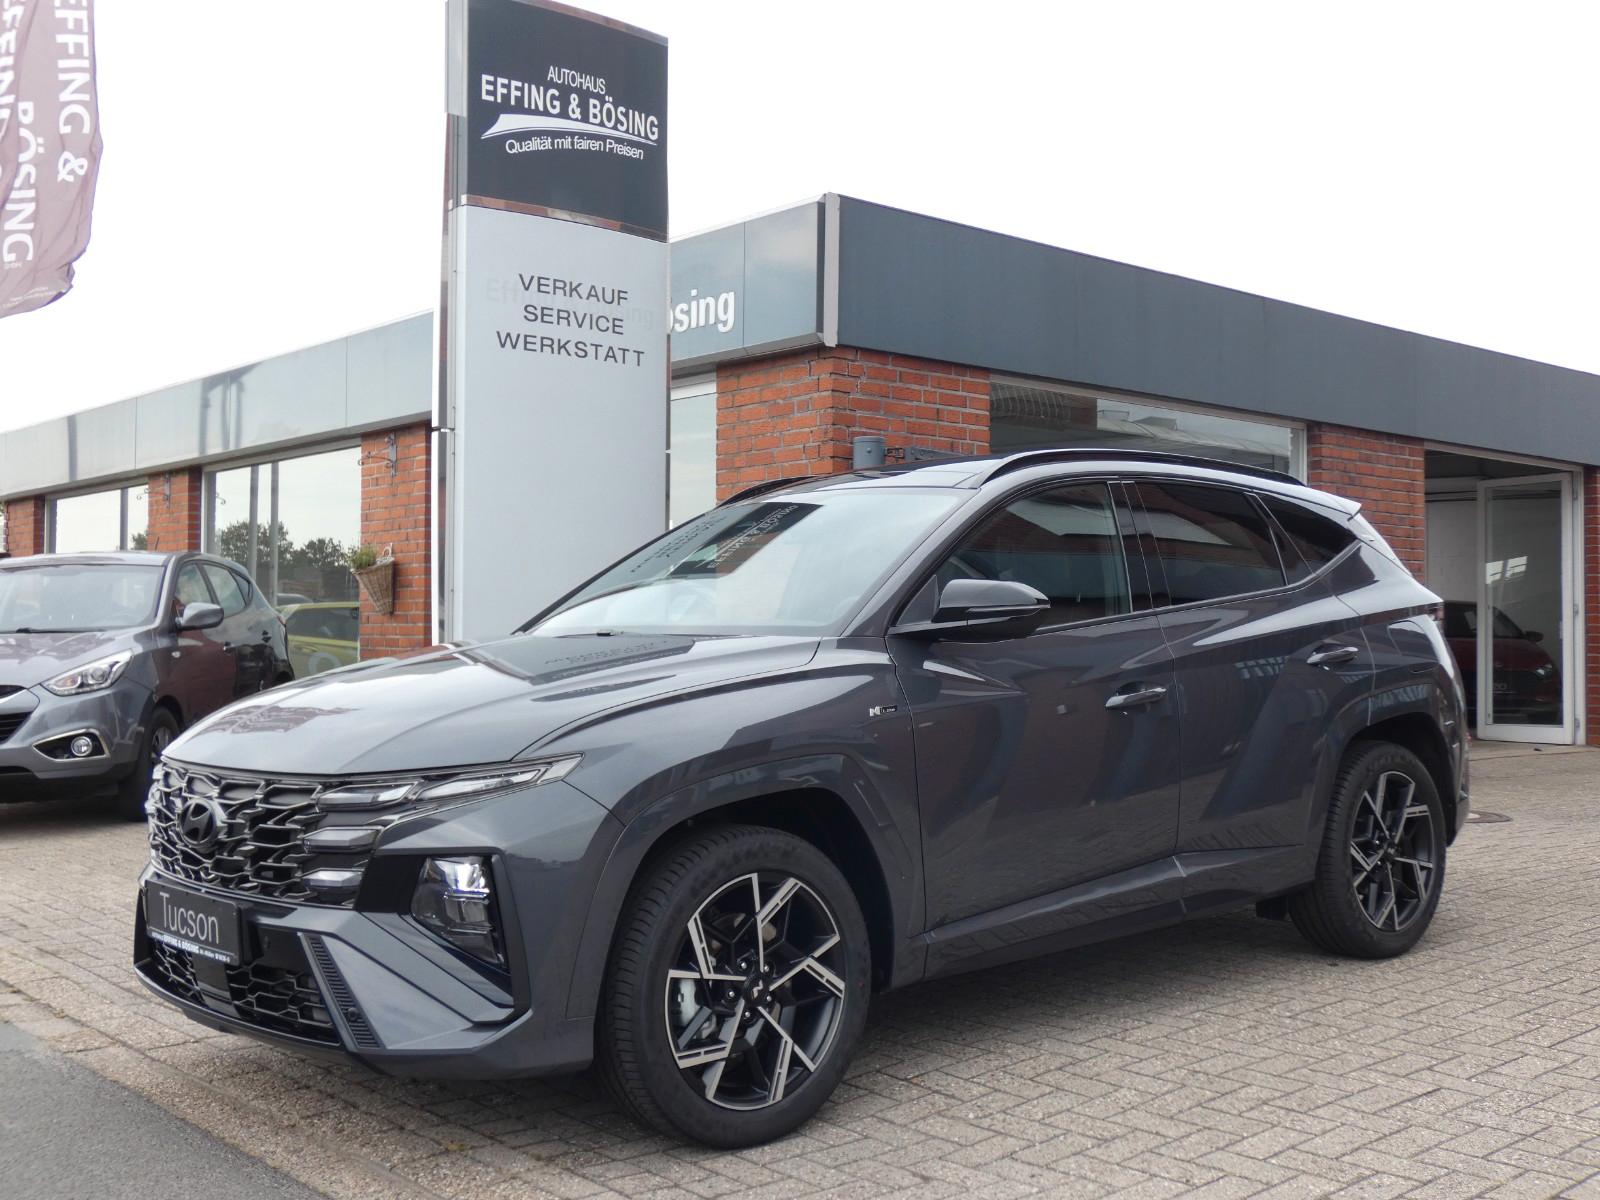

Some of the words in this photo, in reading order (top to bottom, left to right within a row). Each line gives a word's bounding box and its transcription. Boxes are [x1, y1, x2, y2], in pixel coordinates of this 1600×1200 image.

[54, 0, 91, 134] FFING
[547, 65, 606, 95] AUTOHAUS
[481, 73, 561, 115] EFFING
[568, 93, 582, 121] &
[589, 95, 659, 141] BÖSING
[505, 135, 553, 154] Qualität
[554, 136, 573, 150] mit
[574, 136, 604, 152] fairen
[606, 139, 644, 160] Preisen
[57, 151, 88, 183] &
[518, 273, 628, 306] VERKAUF
[523, 304, 624, 335] SERVICE
[667, 288, 735, 334] sing
[496, 330, 645, 367] WERKSTATT
[159, 891, 219, 945] Tucson
